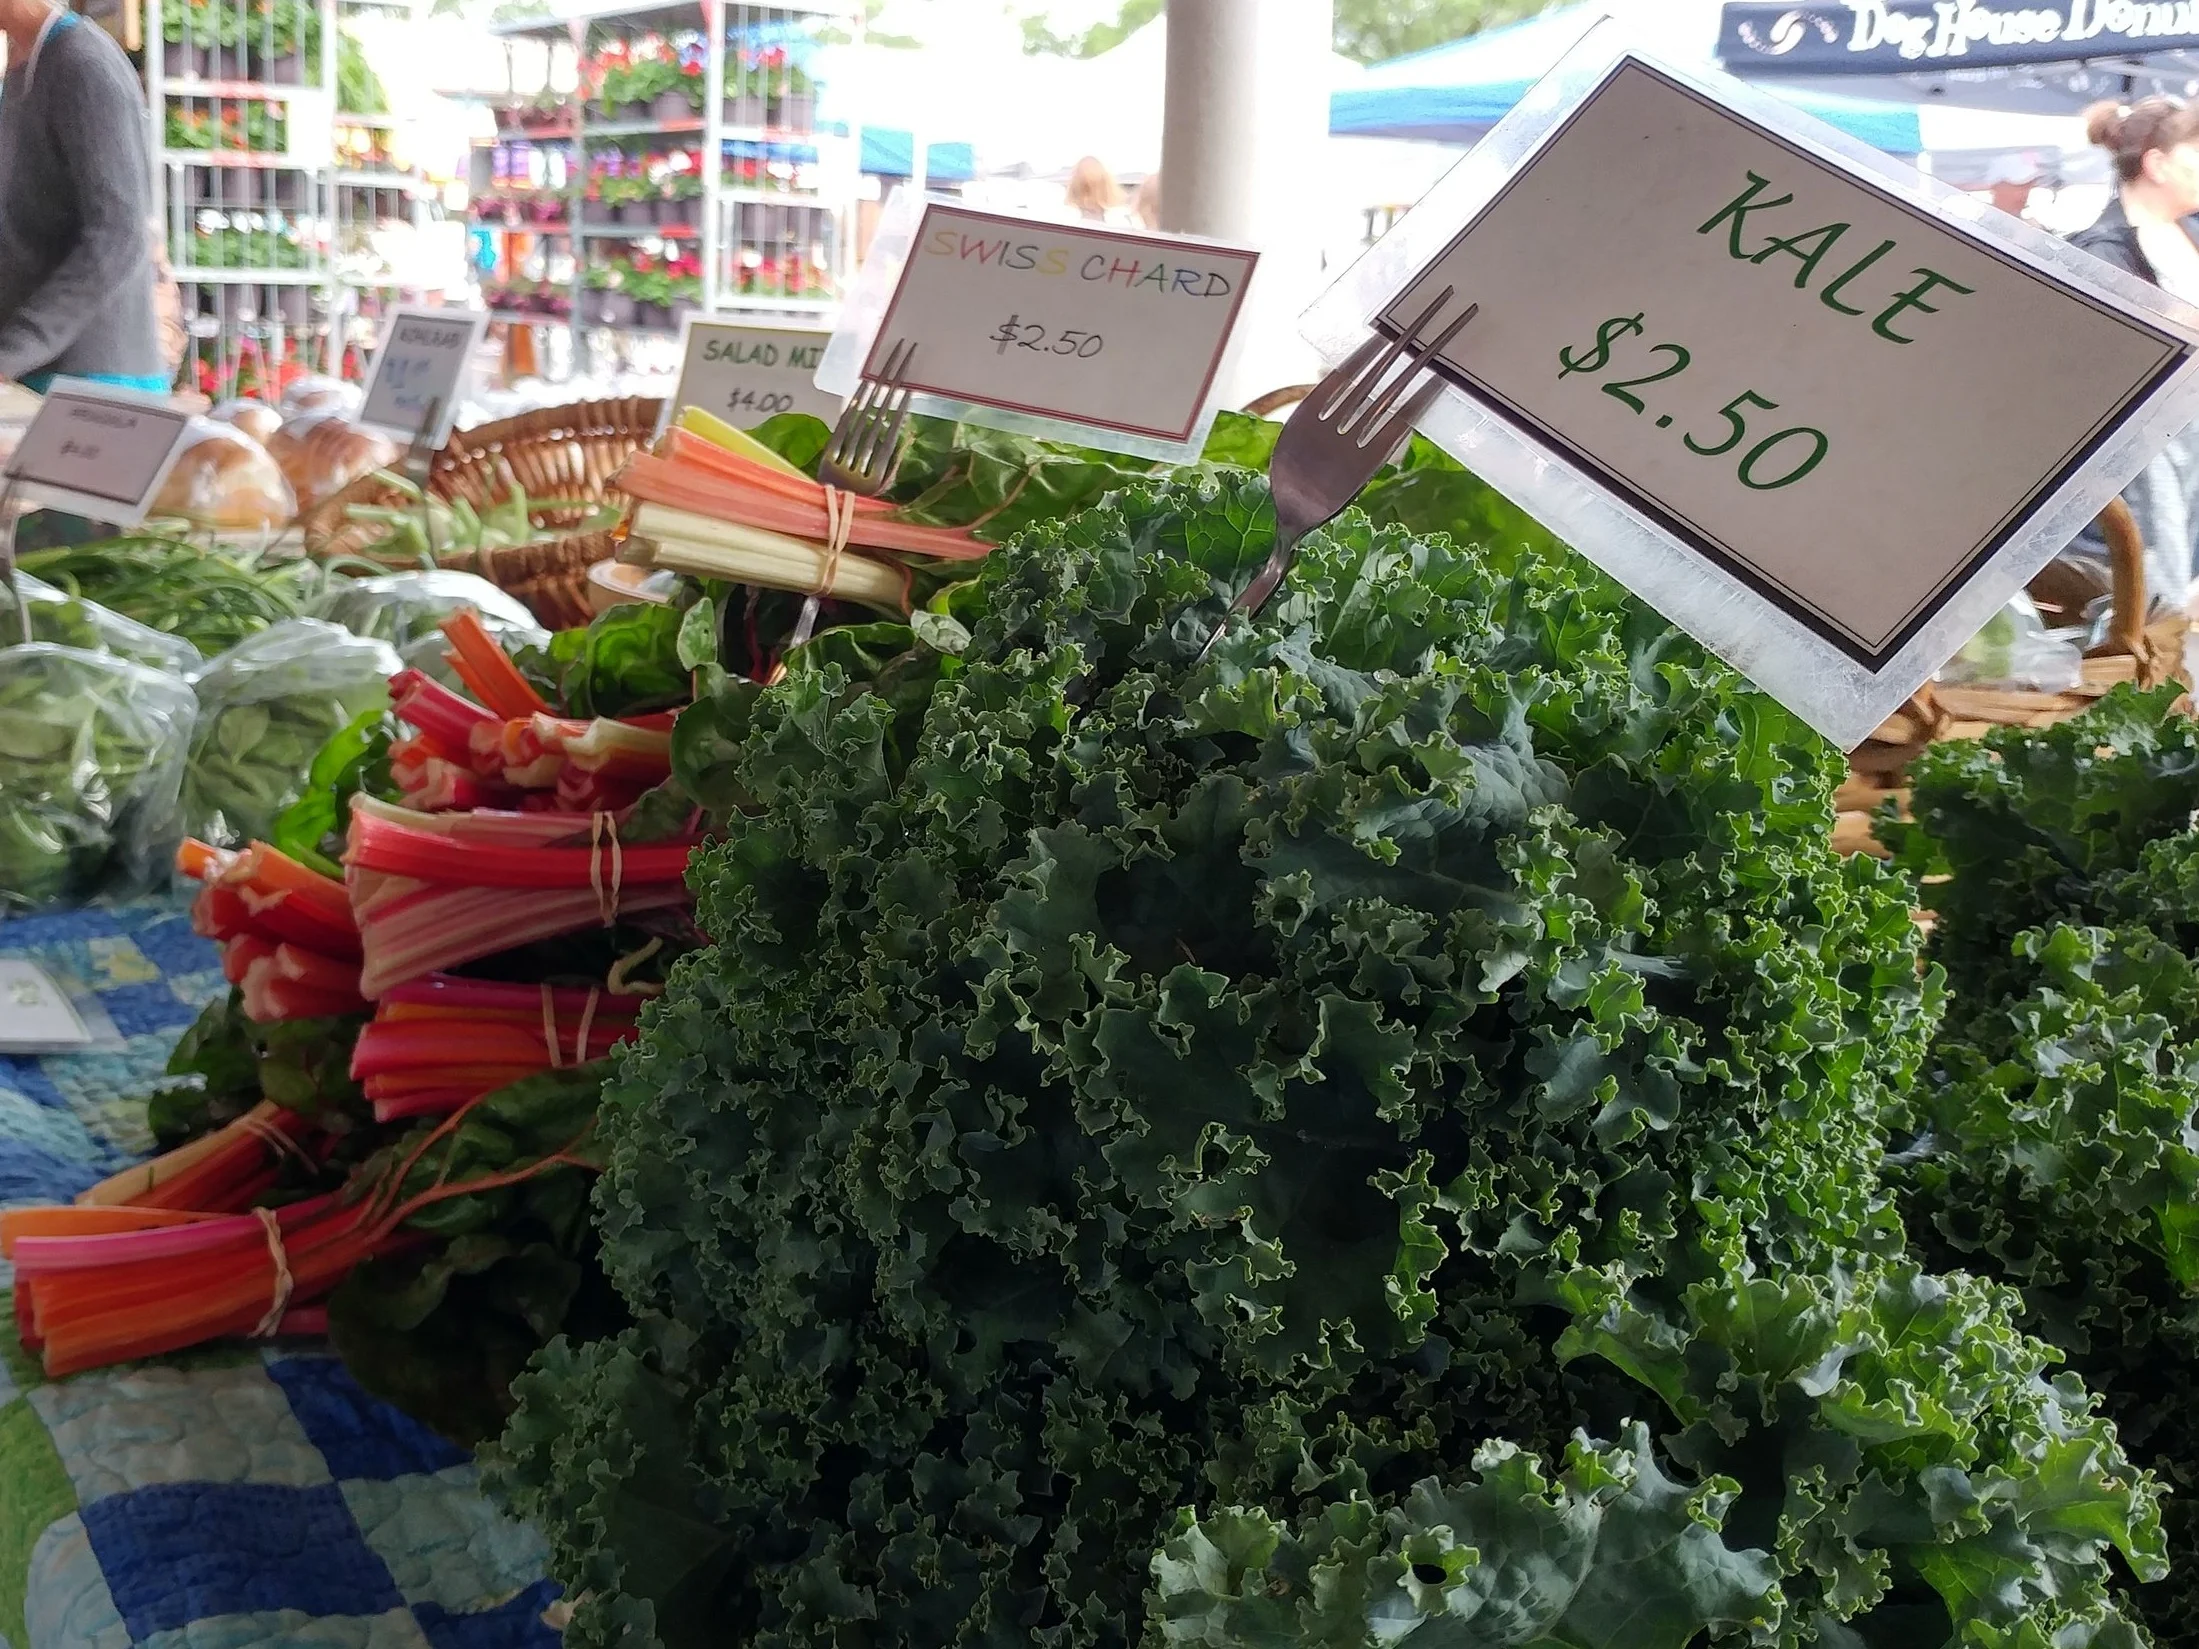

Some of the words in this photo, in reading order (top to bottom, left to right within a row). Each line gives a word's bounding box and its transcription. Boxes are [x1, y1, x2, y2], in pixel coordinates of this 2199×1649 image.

[1840, 0, 1934, 59] Dog
[1925, 0, 2061, 57] House
[2060, 0, 2199, 42] Donu
[924, 230, 1067, 275] SWISS
[1080, 254, 1231, 298] CHARD
[1697, 170, 1975, 344] KALE
[703, 340, 779, 367] SALAD
[786, 345, 825, 369] MI
[989, 314, 1103, 359] $2.50
[727, 388, 794, 413] $4.00
[1557, 312, 1830, 491] $2.50
